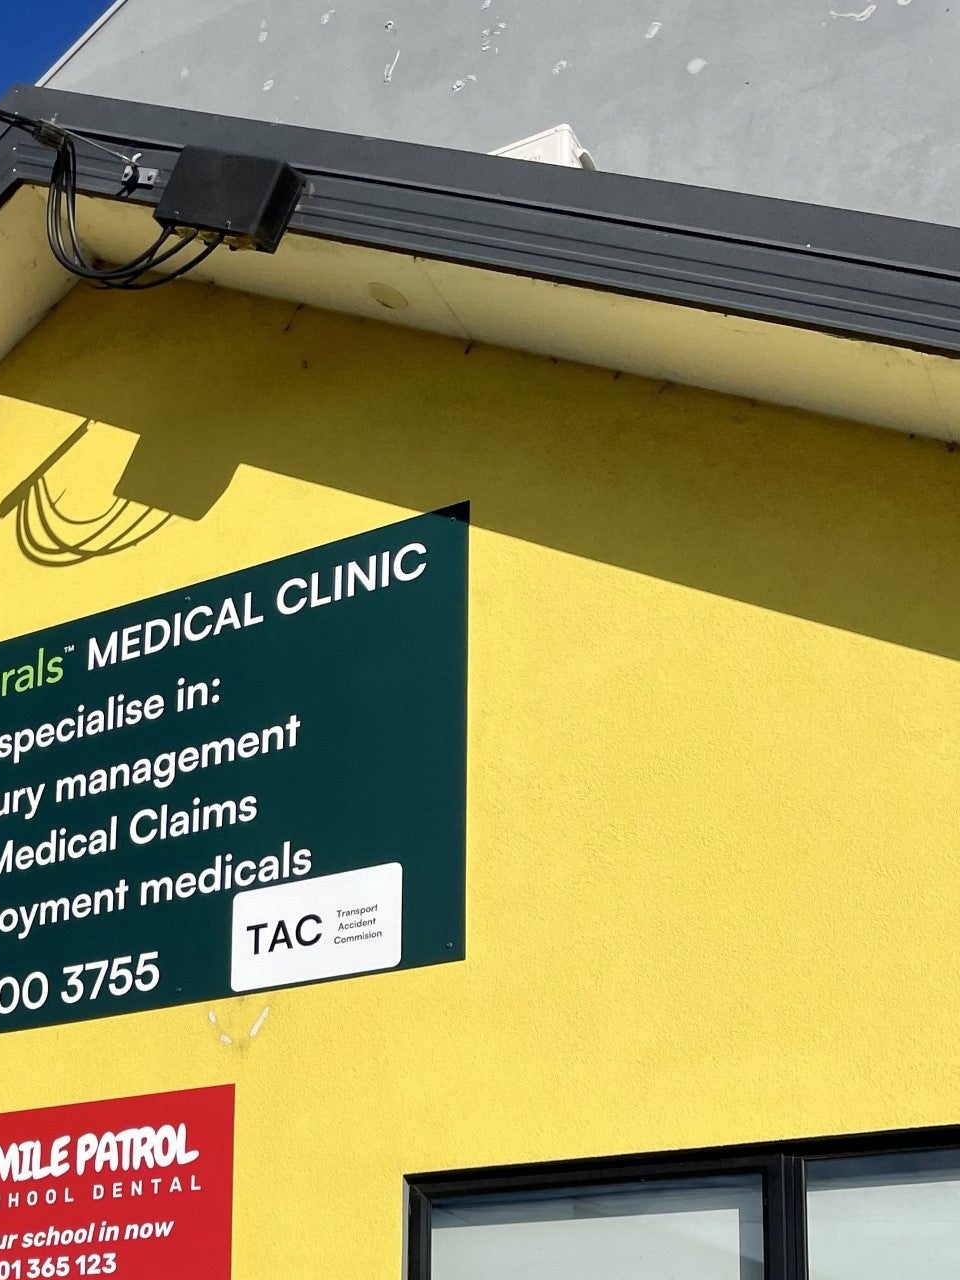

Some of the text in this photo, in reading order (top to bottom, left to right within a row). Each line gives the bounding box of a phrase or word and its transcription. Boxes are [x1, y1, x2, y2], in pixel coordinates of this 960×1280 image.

[87, 591, 264, 671] MEDICAL
[276, 542, 427, 615] CLINIC
[176, 677, 221, 713] in:
[55, 714, 301, 803] management
[129, 795, 258, 845] Claims
[140, 840, 312, 906] medicals
[336, 903, 378, 918] Transport
[337, 918, 376, 931] Accident
[246, 913, 323, 956] TAC
[333, 931, 382, 945] Commision
[60, 950, 160, 1004] 3755
[76, 1122, 200, 1176] PATROL
[92, 1174, 202, 1200] DENTAL
[21, 1222, 96, 1249] school
[97, 1220, 120, 1243] in
[123, 1220, 175, 1240] now
[26, 1256, 71, 1279] 365
[74, 1252, 117, 1276] 123
